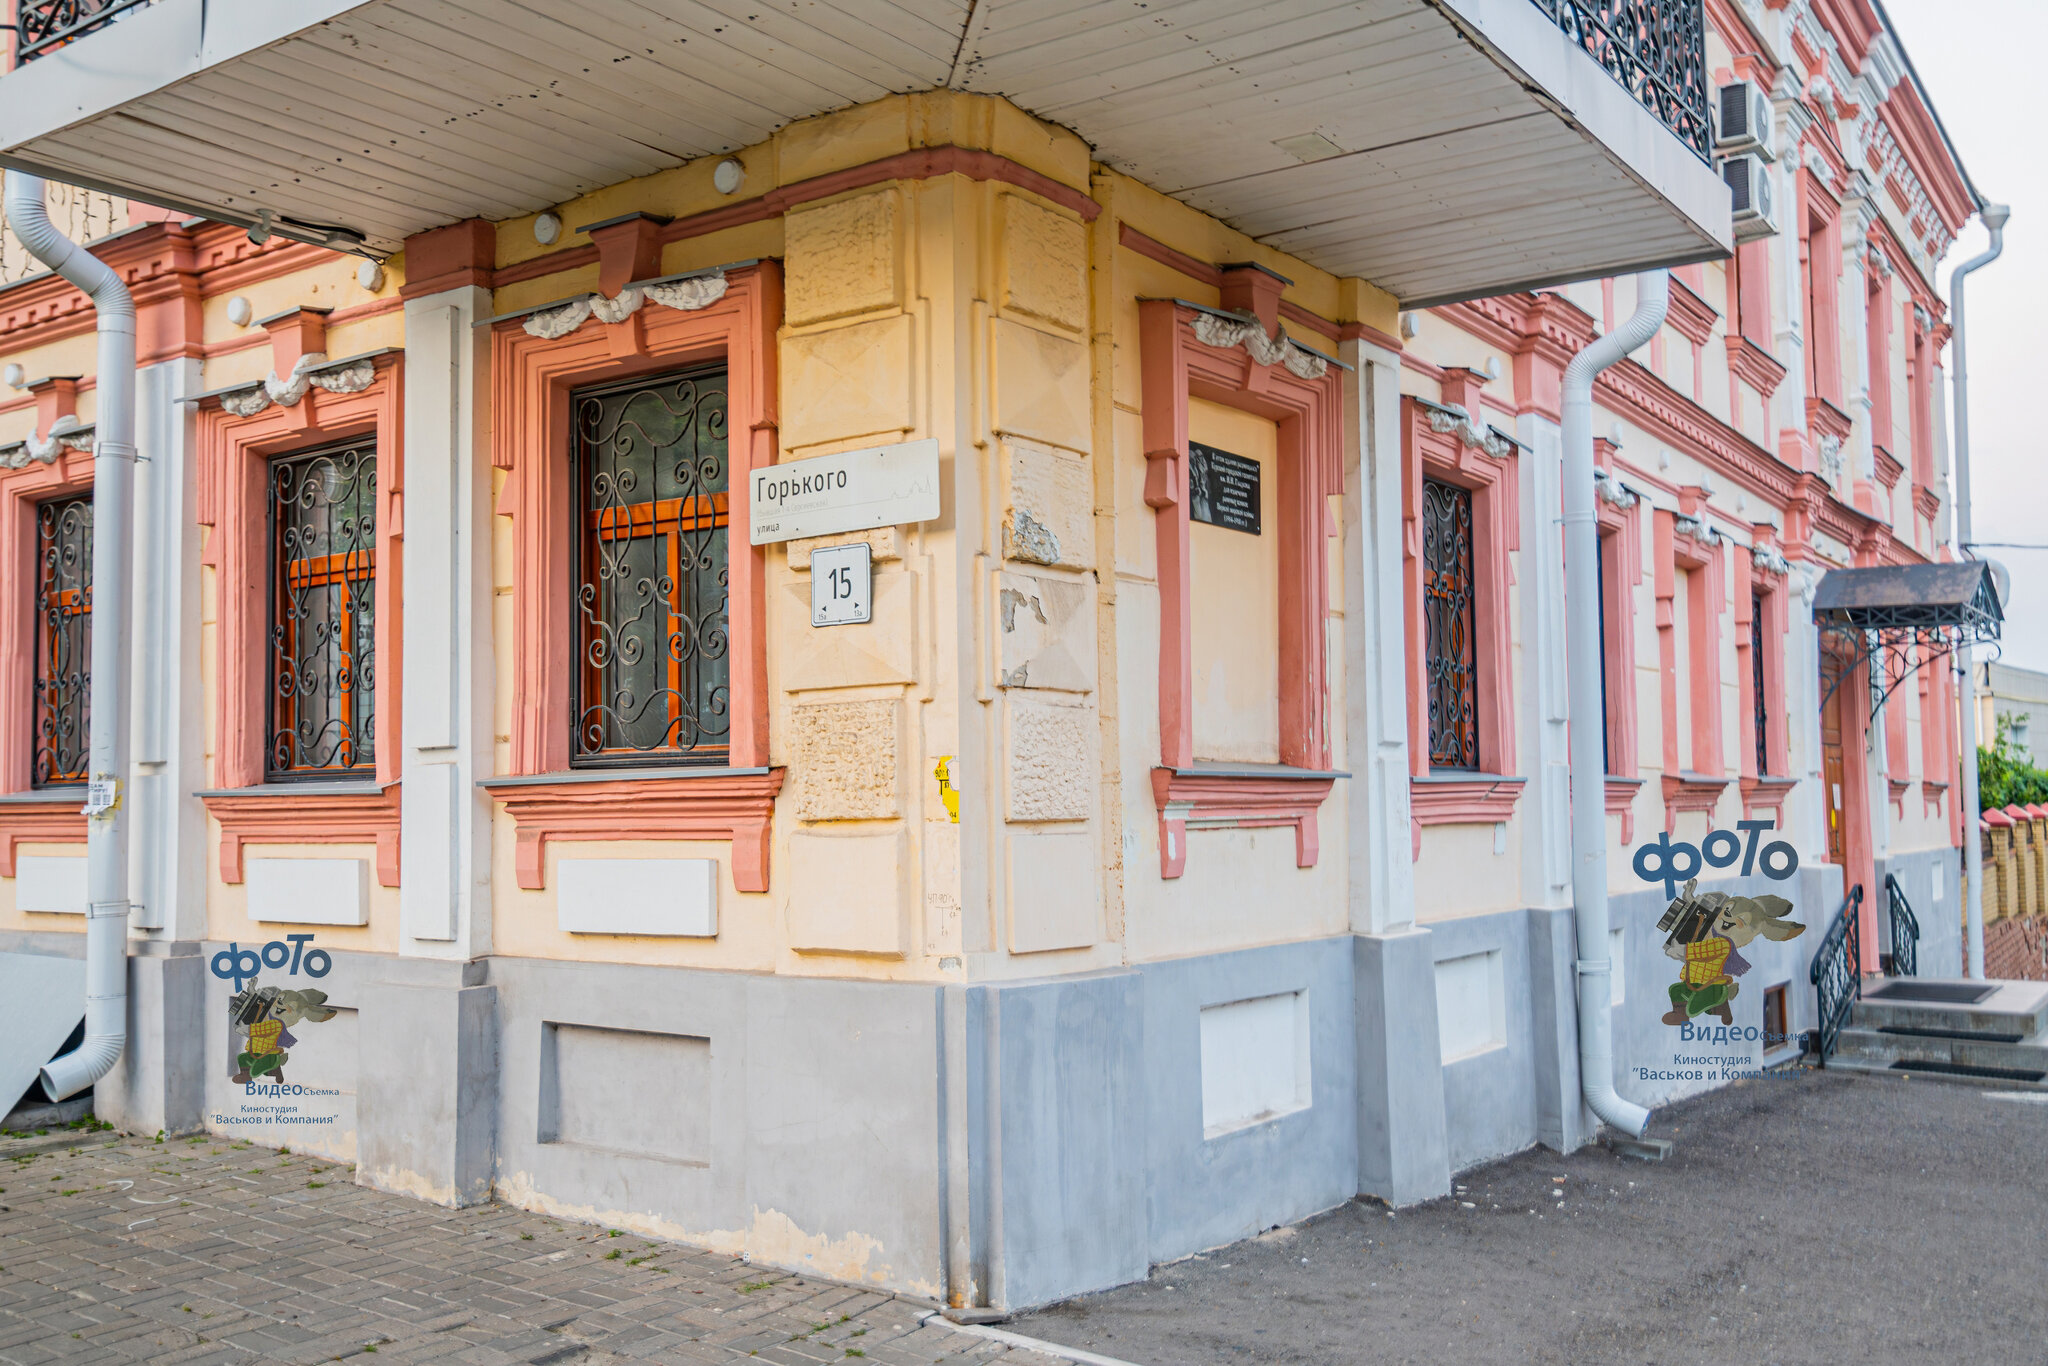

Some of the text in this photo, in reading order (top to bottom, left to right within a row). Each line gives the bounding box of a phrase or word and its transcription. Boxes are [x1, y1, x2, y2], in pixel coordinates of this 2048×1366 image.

[758, 470, 847, 506] Горького
[757, 523, 780, 536] улица
[828, 567, 852, 600] 15
